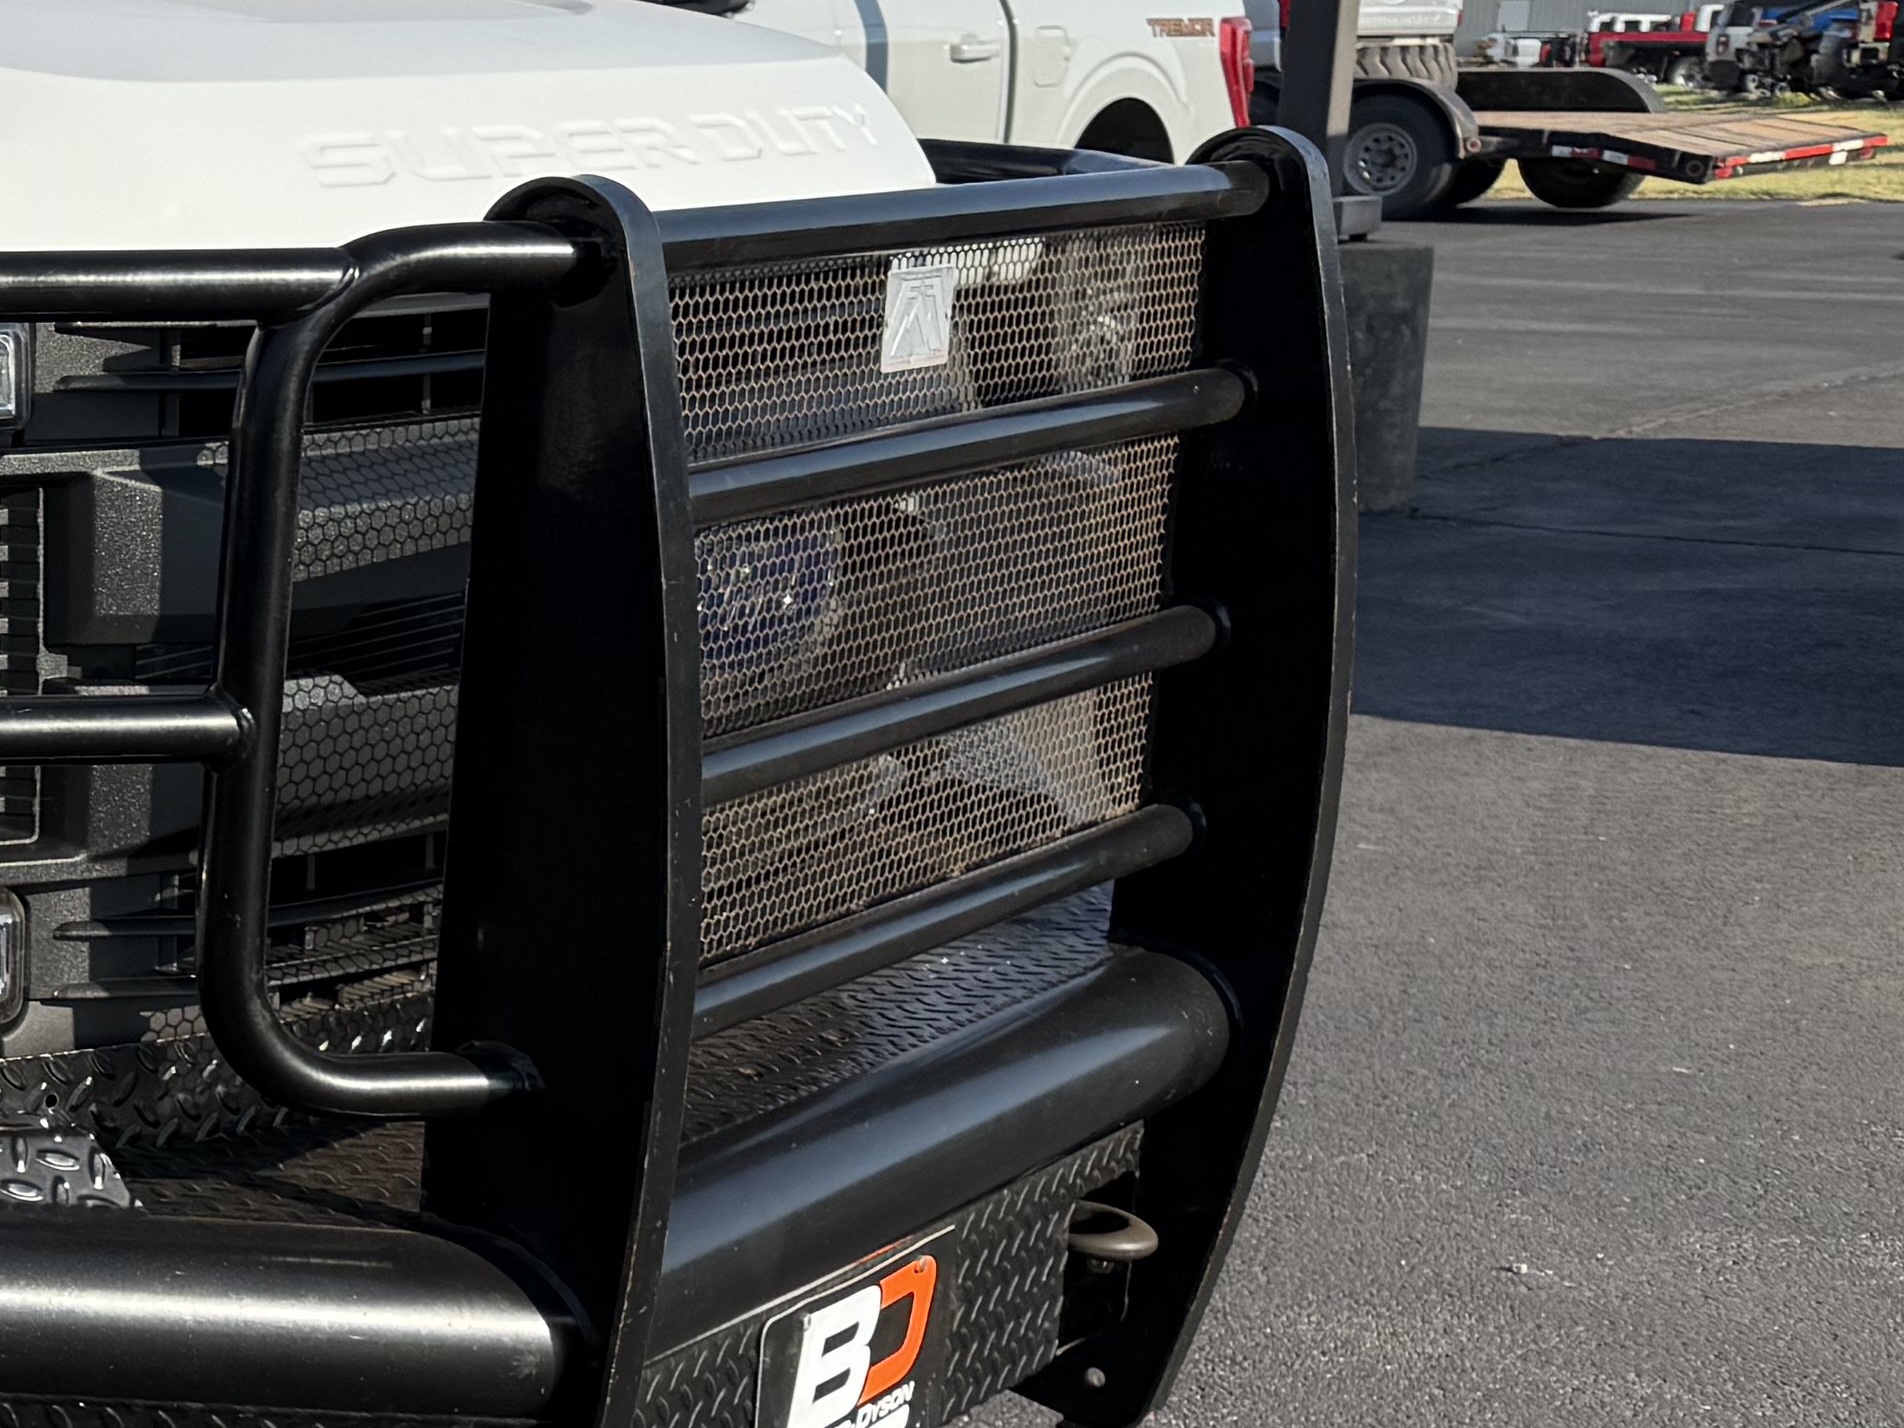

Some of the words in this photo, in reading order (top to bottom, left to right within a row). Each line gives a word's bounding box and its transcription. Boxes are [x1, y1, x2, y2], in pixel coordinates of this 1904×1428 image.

[1145, 18, 1216, 38] TREMOR
[298, 117, 700, 189] SUPER
[689, 102, 879, 162] DUTY
